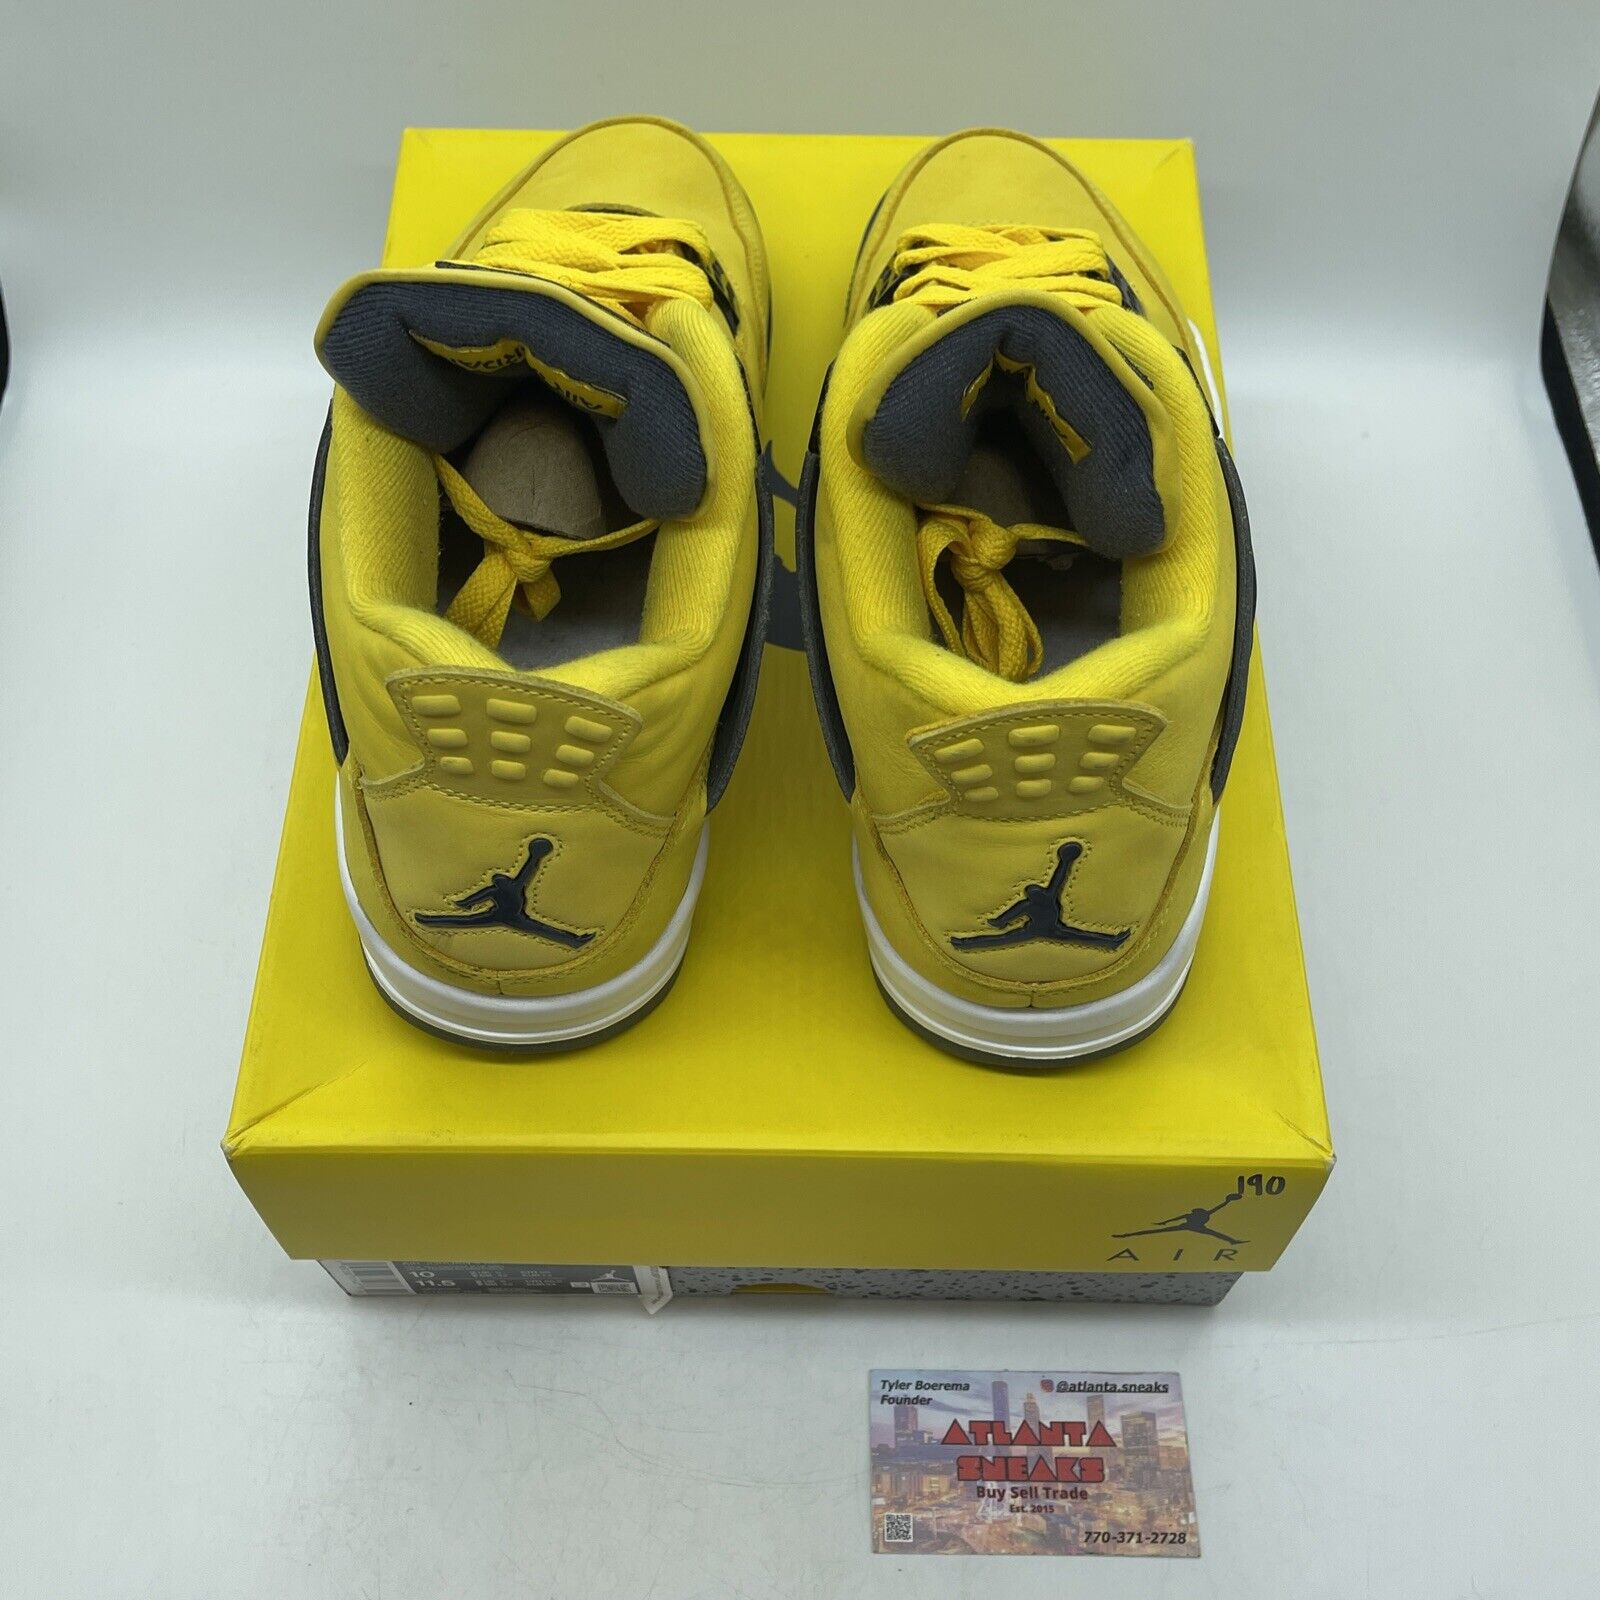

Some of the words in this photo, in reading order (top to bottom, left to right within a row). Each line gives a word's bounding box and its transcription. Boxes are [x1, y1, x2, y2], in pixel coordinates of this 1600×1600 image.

[1237, 1173, 1286, 1196] 190
[1106, 1248, 1239, 1262] AIR
[880, 1379, 914, 1392] Tyler
[915, 1380, 970, 1392] Boerema
[1056, 1380, 1169, 1394] @atlanta.sneaks
[880, 1394, 933, 1406] Founder
[941, 1418, 1118, 1447] ATLANTA
[956, 1454, 1106, 1483] SNEAKS
[976, 1486, 1005, 1502] Buy
[1010, 1486, 1039, 1500] Sell
[1044, 1486, 1089, 1501] Trade
[1009, 1504, 1029, 1514] Est.
[1030, 1504, 1055, 1514] 2015
[1083, 1531, 1188, 1545] 770-371-2728
